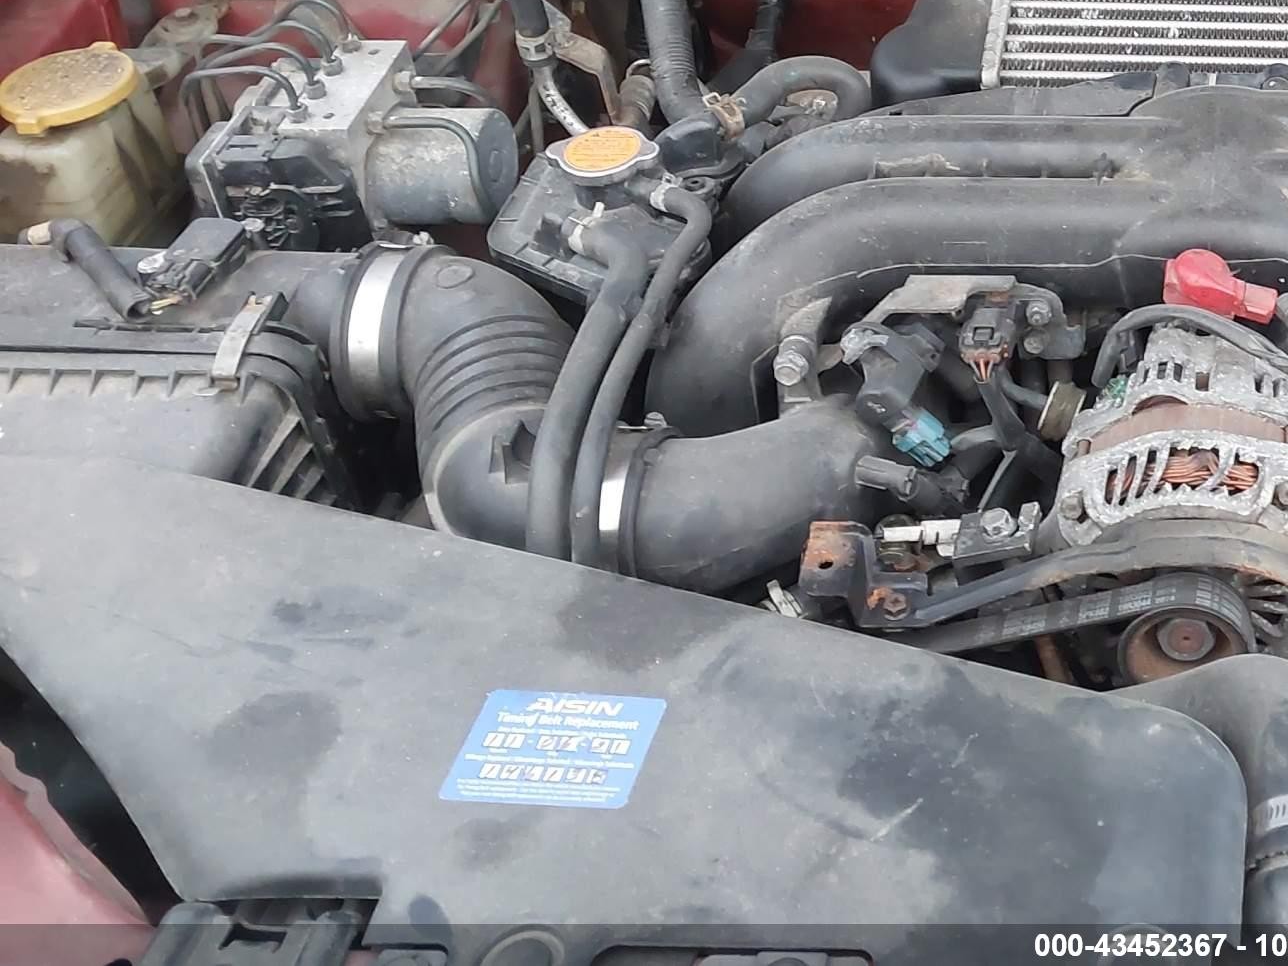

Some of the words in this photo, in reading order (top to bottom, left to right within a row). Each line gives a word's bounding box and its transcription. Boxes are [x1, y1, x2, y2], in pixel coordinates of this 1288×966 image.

[526, 697, 624, 716] AISIN
[497, 712, 538, 727] Timing
[537, 714, 563, 726] Belt
[563, 716, 640, 730] Replacement
